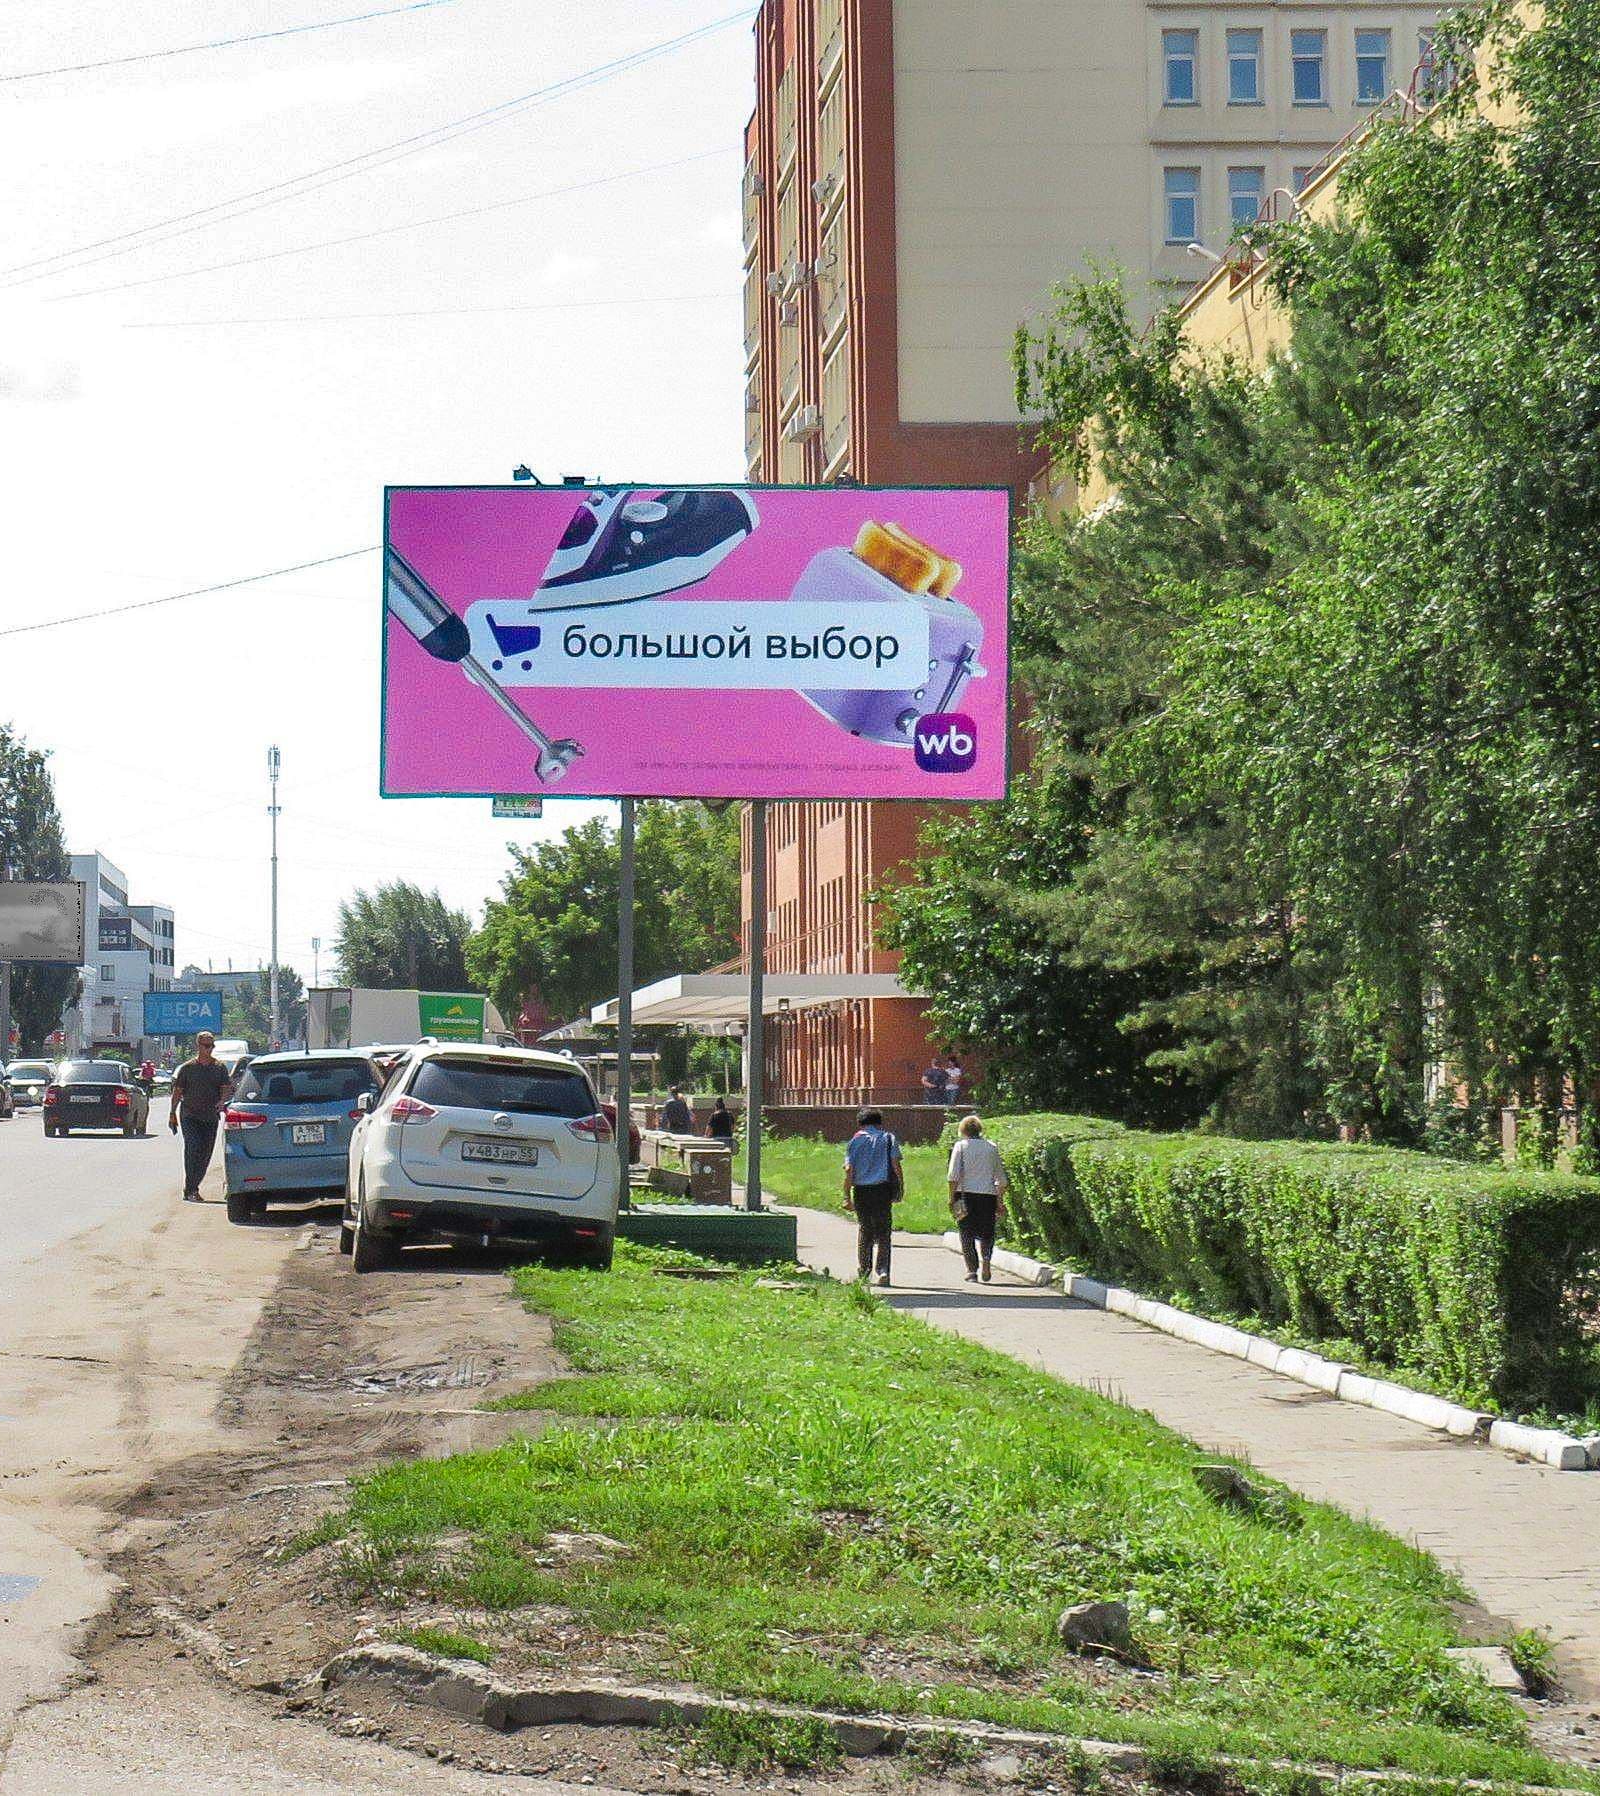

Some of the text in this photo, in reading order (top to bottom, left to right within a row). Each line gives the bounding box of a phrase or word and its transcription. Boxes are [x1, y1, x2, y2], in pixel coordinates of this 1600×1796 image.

[563, 624, 900, 669] большой выбор
[918, 725, 974, 756] wb
